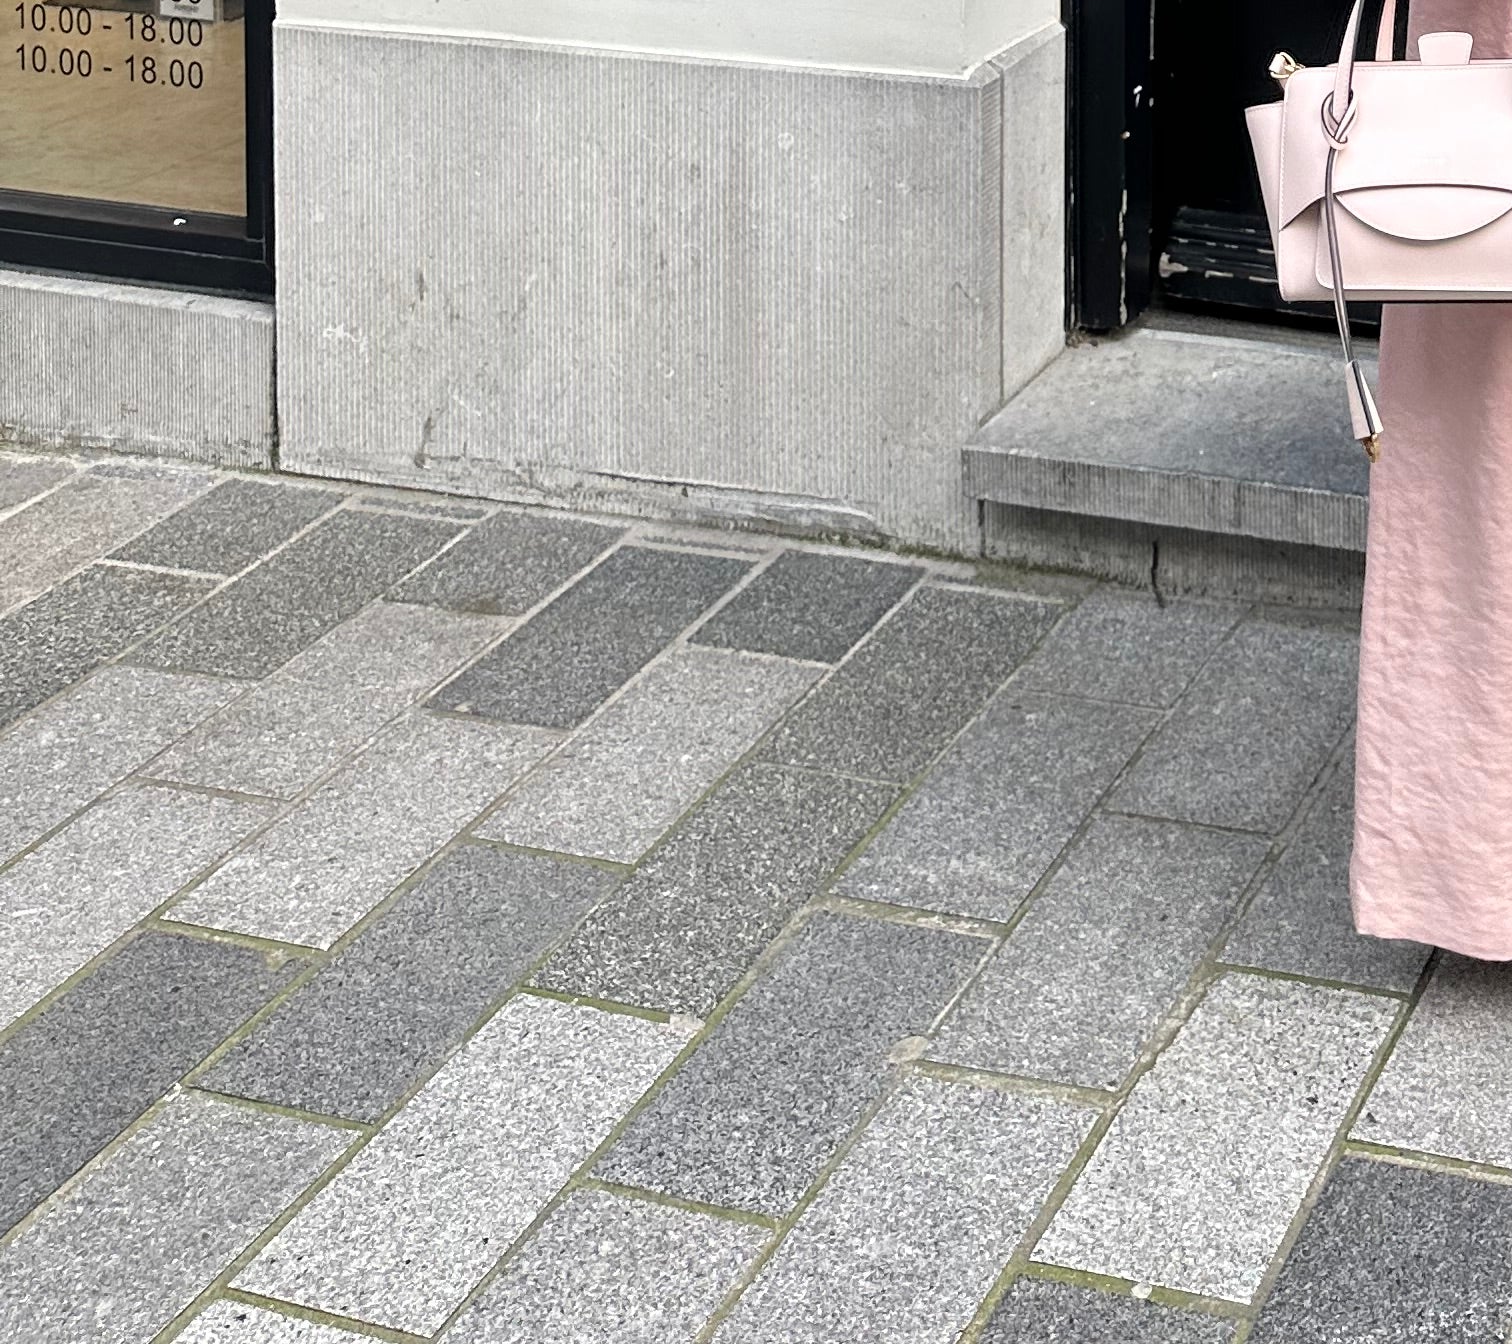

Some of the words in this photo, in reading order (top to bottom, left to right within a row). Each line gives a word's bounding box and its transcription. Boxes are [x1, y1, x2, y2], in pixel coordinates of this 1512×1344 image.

[15, 2, 92, 36] 10.00
[124, 13, 203, 47] 18.00
[16, 44, 92, 77] 10.00
[125, 55, 204, 89] 18.00
